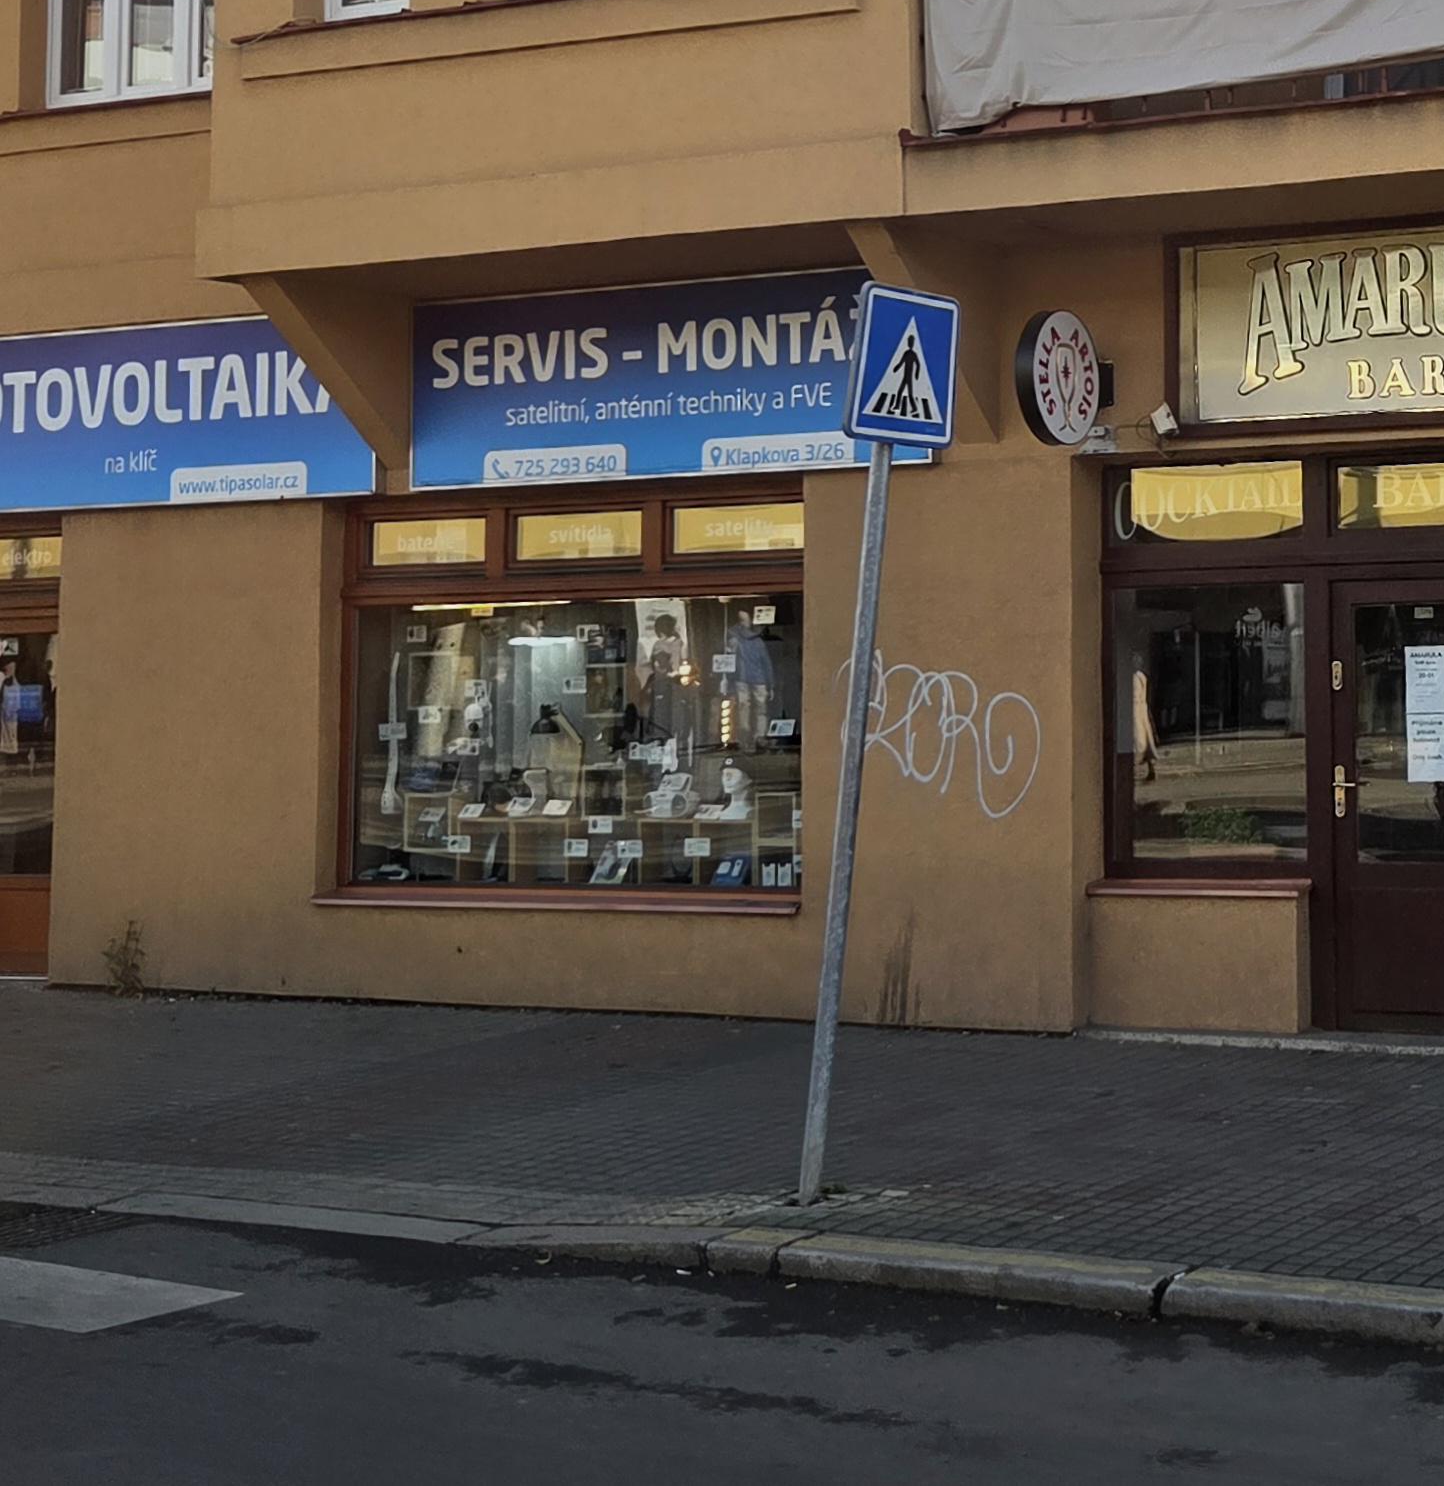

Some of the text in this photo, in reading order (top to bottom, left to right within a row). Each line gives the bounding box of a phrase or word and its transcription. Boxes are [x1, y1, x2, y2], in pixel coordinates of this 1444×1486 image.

[432, 327, 609, 389] SERVIS
[1039, 326, 1094, 421] STELLA ARTOIS
[506, 382, 833, 426] satelitní, anténní techniky a FVE
[104, 449, 157, 474] na klíč
[514, 455, 617, 477] 725 293 640
[725, 442, 845, 467] Klapkova 3/26
[178, 473, 299, 495] www.tipasolar.cz
[549, 524, 614, 545] svítidla
